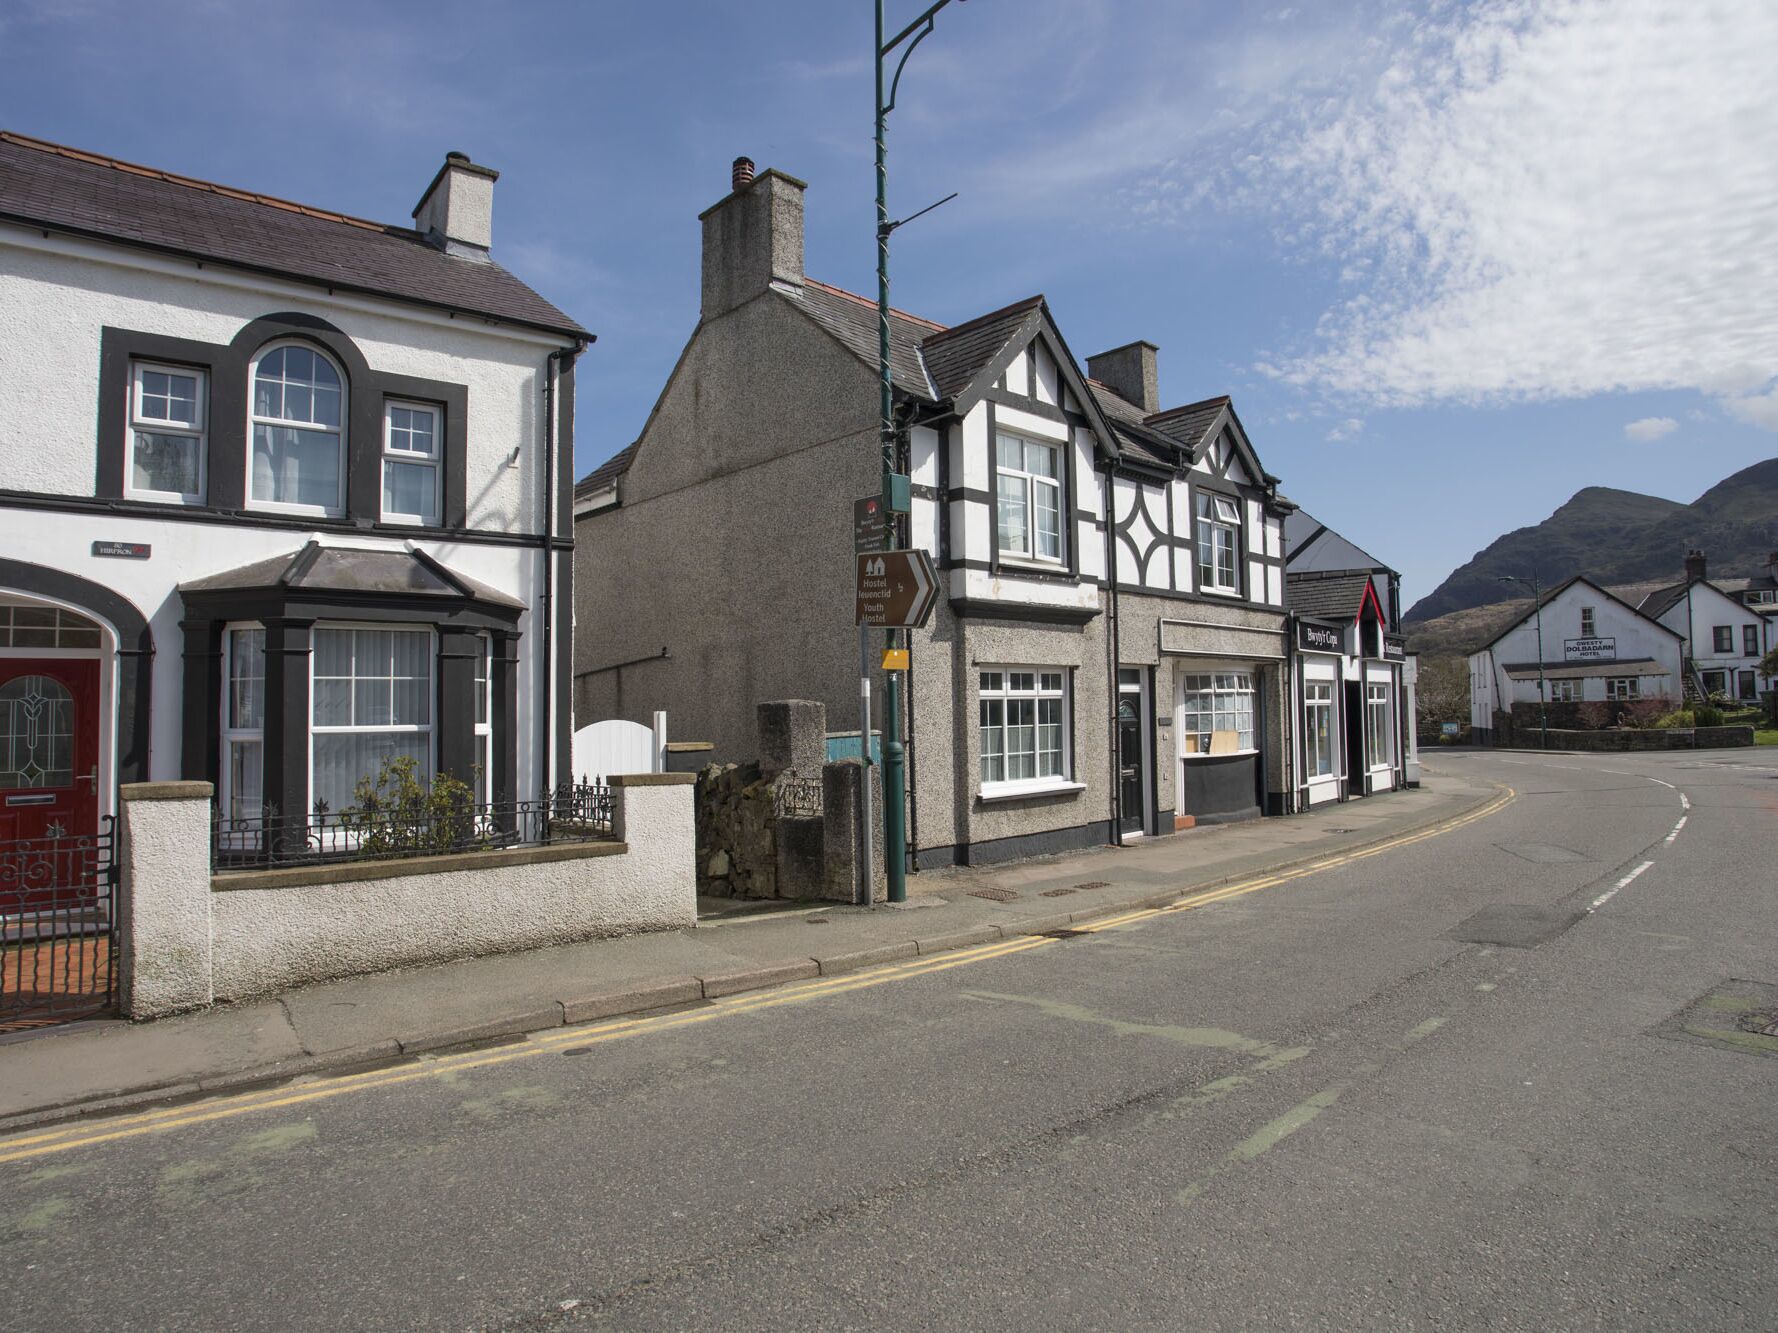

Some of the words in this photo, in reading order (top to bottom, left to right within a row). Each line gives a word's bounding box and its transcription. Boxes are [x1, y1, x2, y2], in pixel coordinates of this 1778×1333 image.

[863, 578, 887, 588] Hostel
[863, 602, 884, 612] Youth
[862, 613, 886, 623] Hostel
